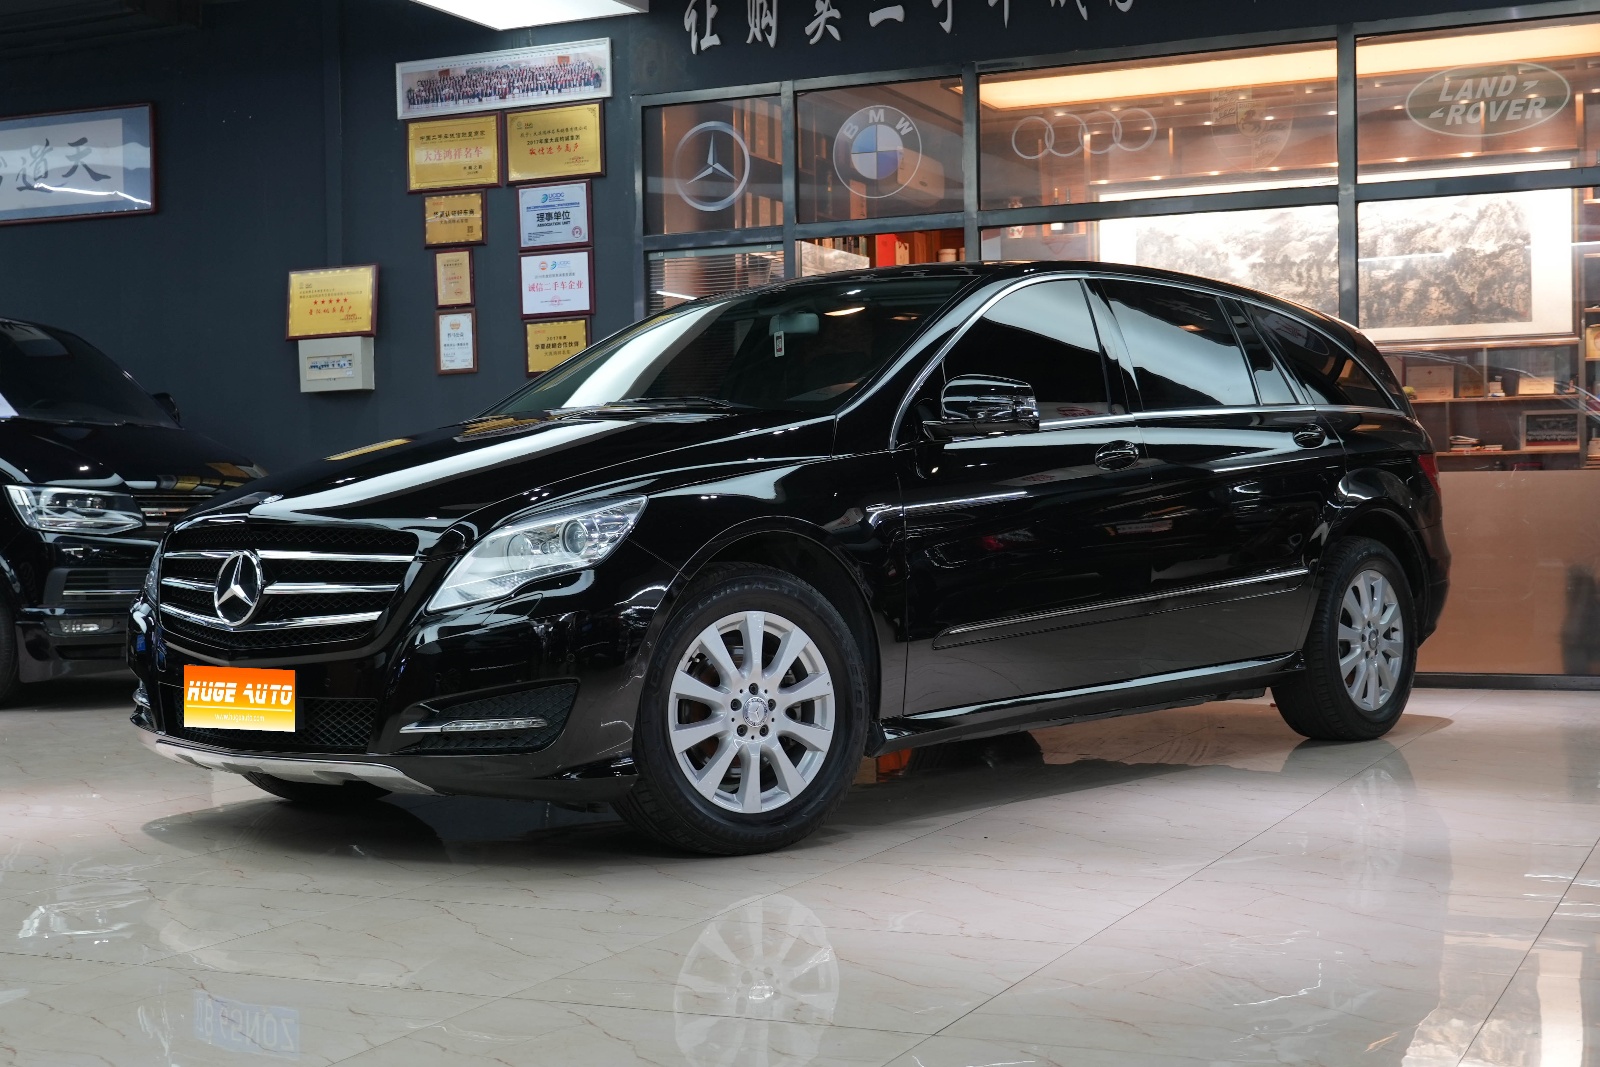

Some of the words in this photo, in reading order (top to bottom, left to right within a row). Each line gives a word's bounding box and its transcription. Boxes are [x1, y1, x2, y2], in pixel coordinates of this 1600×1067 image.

[1438, 75, 1517, 102] LAND
[1445, 97, 1547, 126] ROVER
[842, 108, 914, 139] BMW
[424, 146, 483, 162] 大连鸿祥名车
[536, 210, 571, 223] 理事单位
[528, 280, 584, 293] 诚信二手车企业
